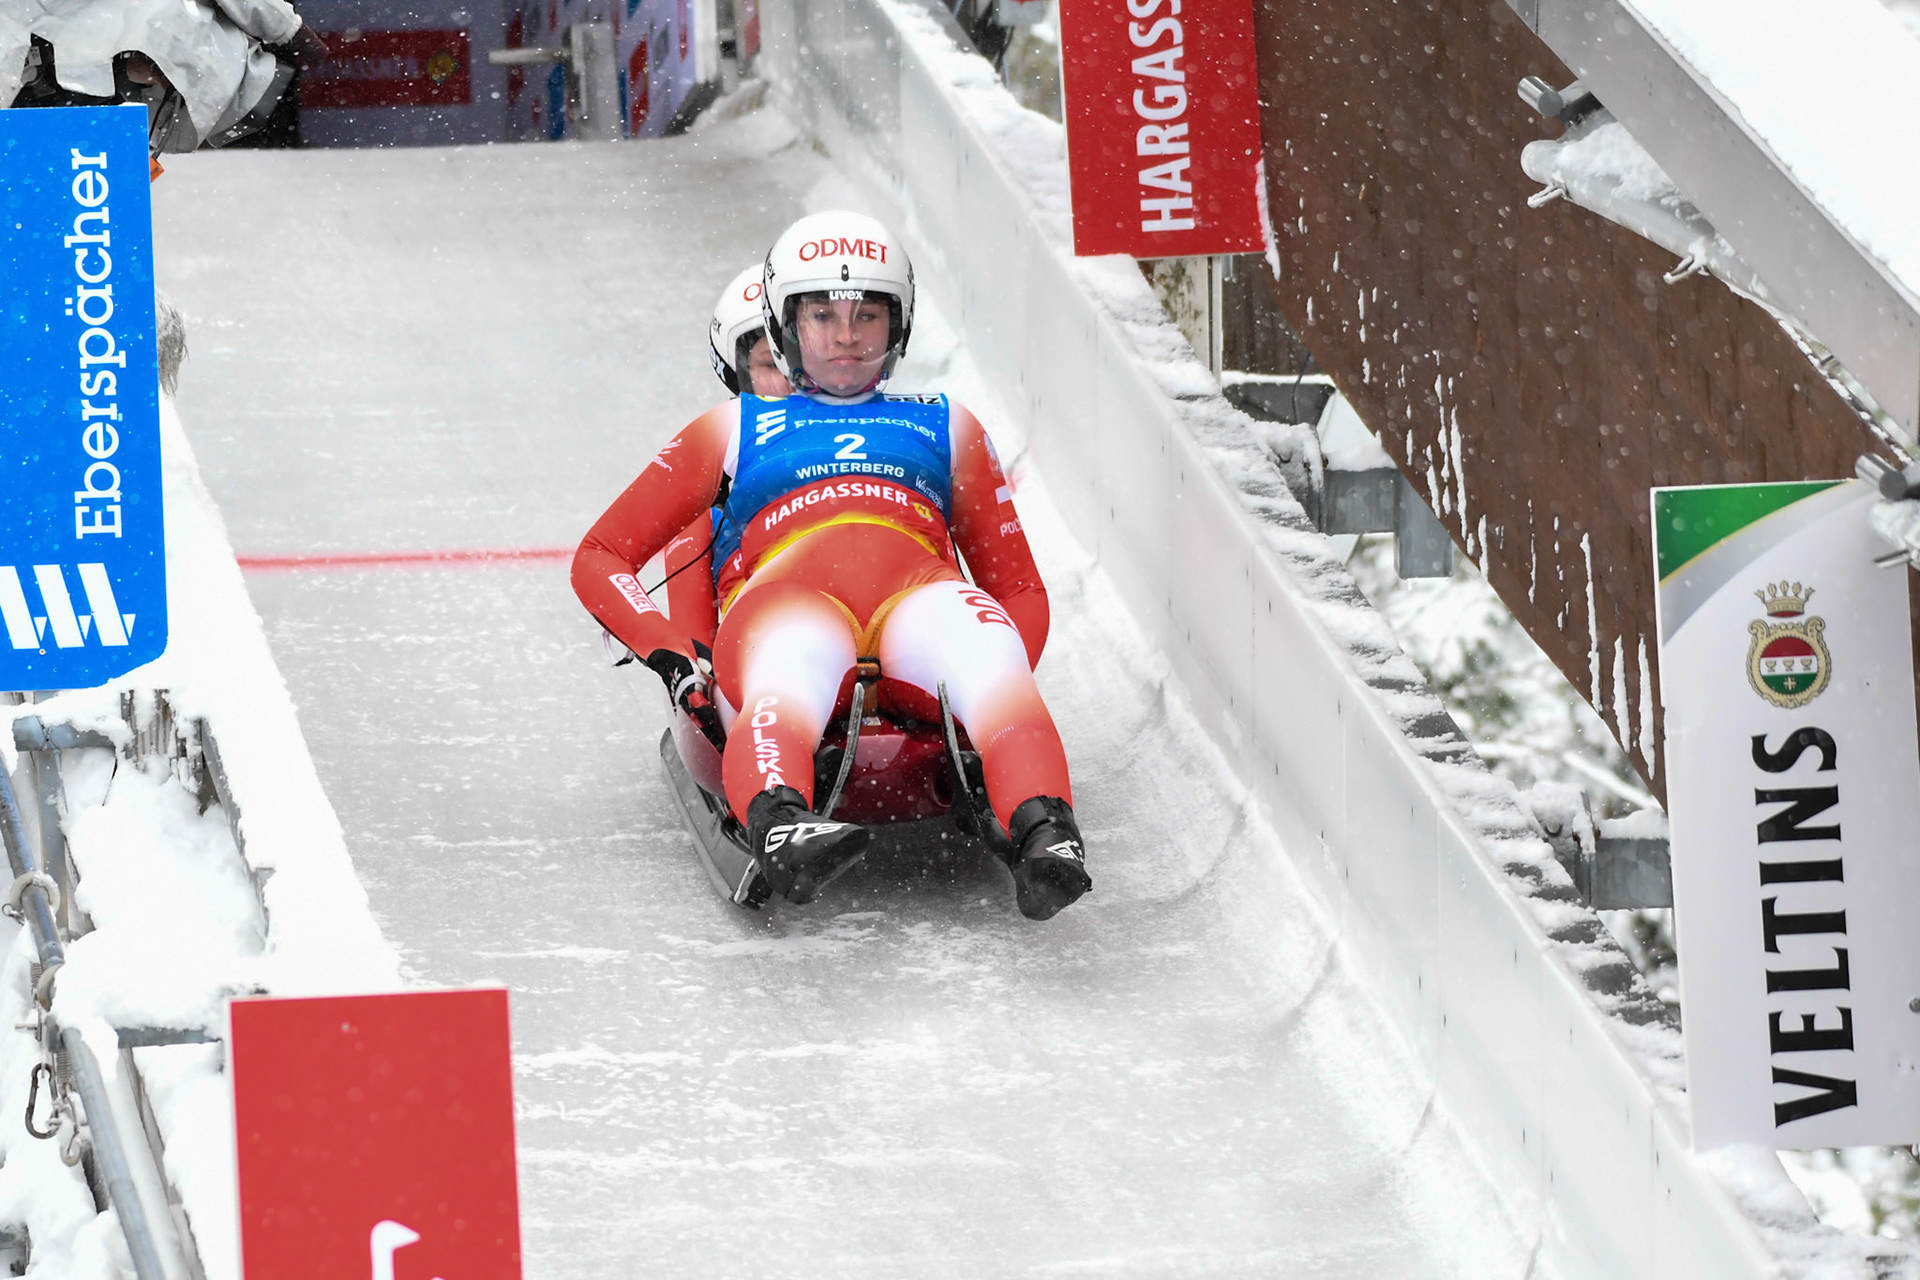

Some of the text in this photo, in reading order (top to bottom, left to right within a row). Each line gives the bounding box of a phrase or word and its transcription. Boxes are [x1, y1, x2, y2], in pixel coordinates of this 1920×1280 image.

[799, 238, 888, 264] ODMET
[829, 290, 864, 301] uvex
[64, 148, 127, 540] Eberspächer
[834, 433, 868, 460] 2
[796, 462, 905, 480] WINTERBERG
[765, 482, 909, 532] HARGASSNER
[615, 575, 656, 611] ODMET
[751, 696, 787, 791] POLSKA
[764, 822, 850, 853] GTS
[1751, 726, 1858, 1128] VELTINS
